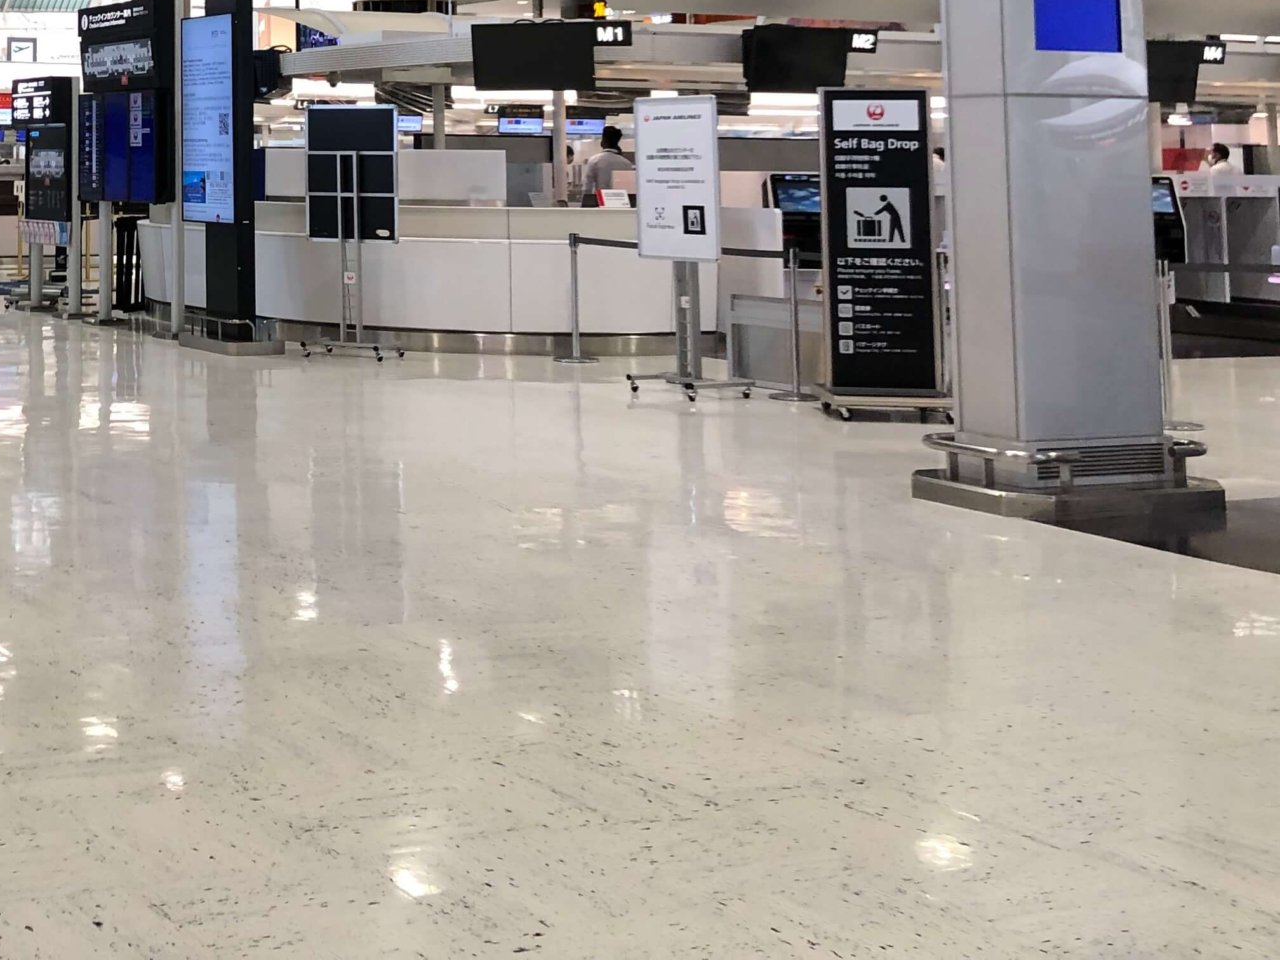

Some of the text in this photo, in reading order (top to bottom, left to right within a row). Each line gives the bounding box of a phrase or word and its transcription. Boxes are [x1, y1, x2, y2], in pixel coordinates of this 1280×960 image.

[596, 26, 624, 42] M1
[852, 33, 876, 49] M2
[1203, 45, 1223, 61] M4
[488, 105, 499, 113] L7
[834, 138, 919, 151] Self Bag Drop
